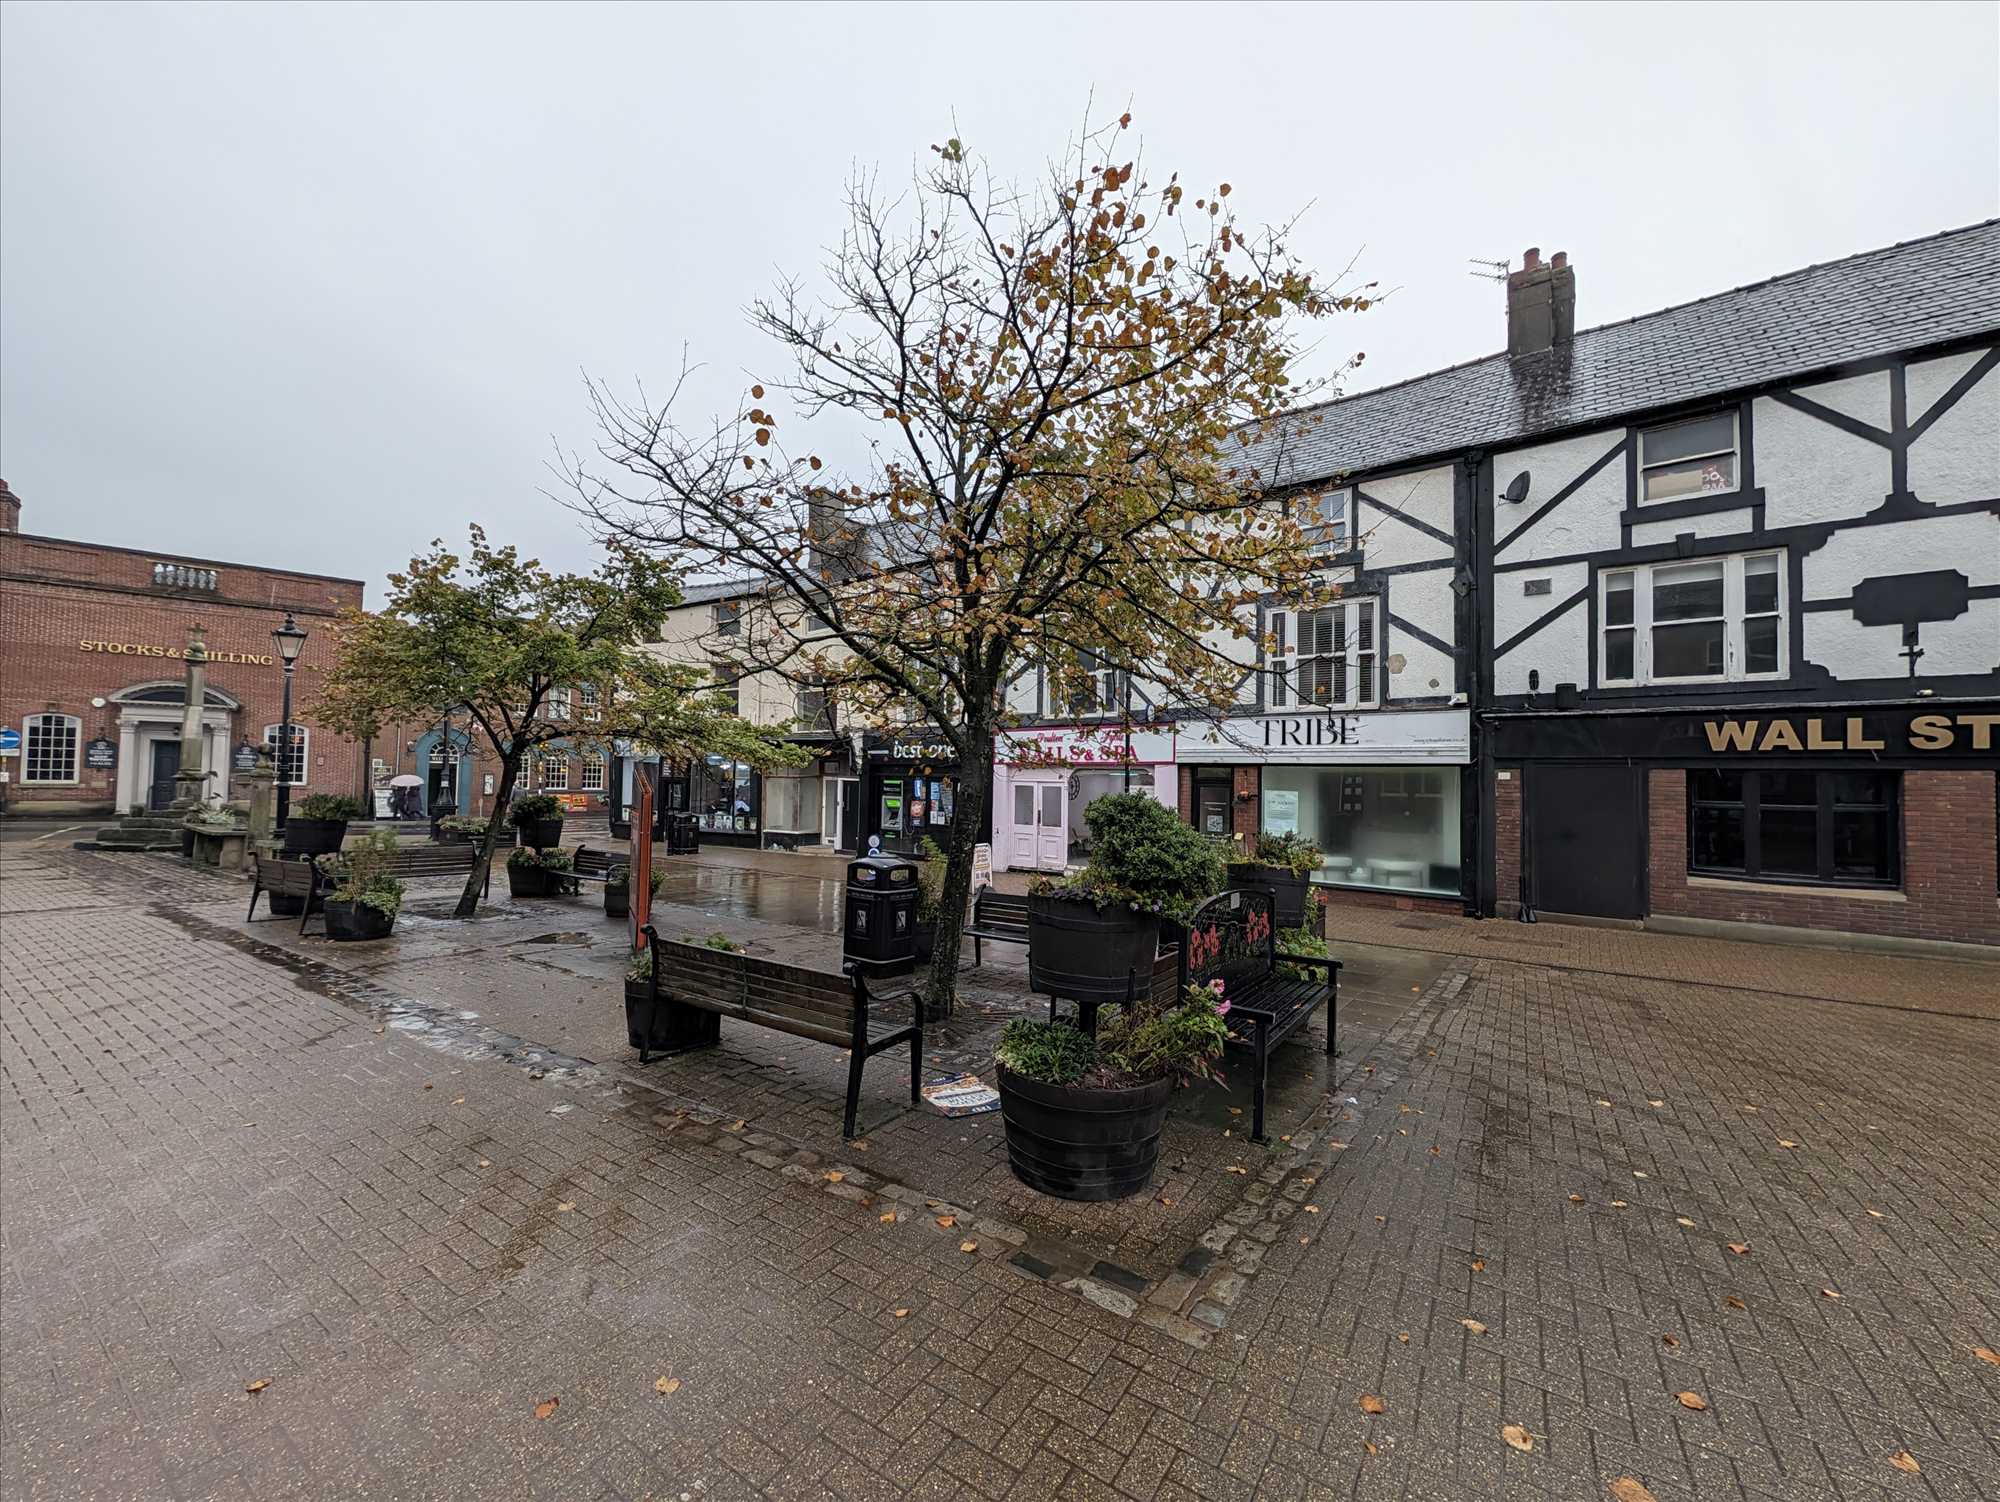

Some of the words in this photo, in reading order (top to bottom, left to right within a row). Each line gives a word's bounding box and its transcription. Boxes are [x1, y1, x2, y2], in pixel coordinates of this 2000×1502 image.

[80, 640, 164, 657] STOCKS
[183, 648, 273, 666] SILLING
[1256, 716, 1360, 746] TRIBE
[1703, 717, 1885, 751] WALL
[1908, 714, 2000, 750] ST
[1099, 745, 1139, 762] SPA
